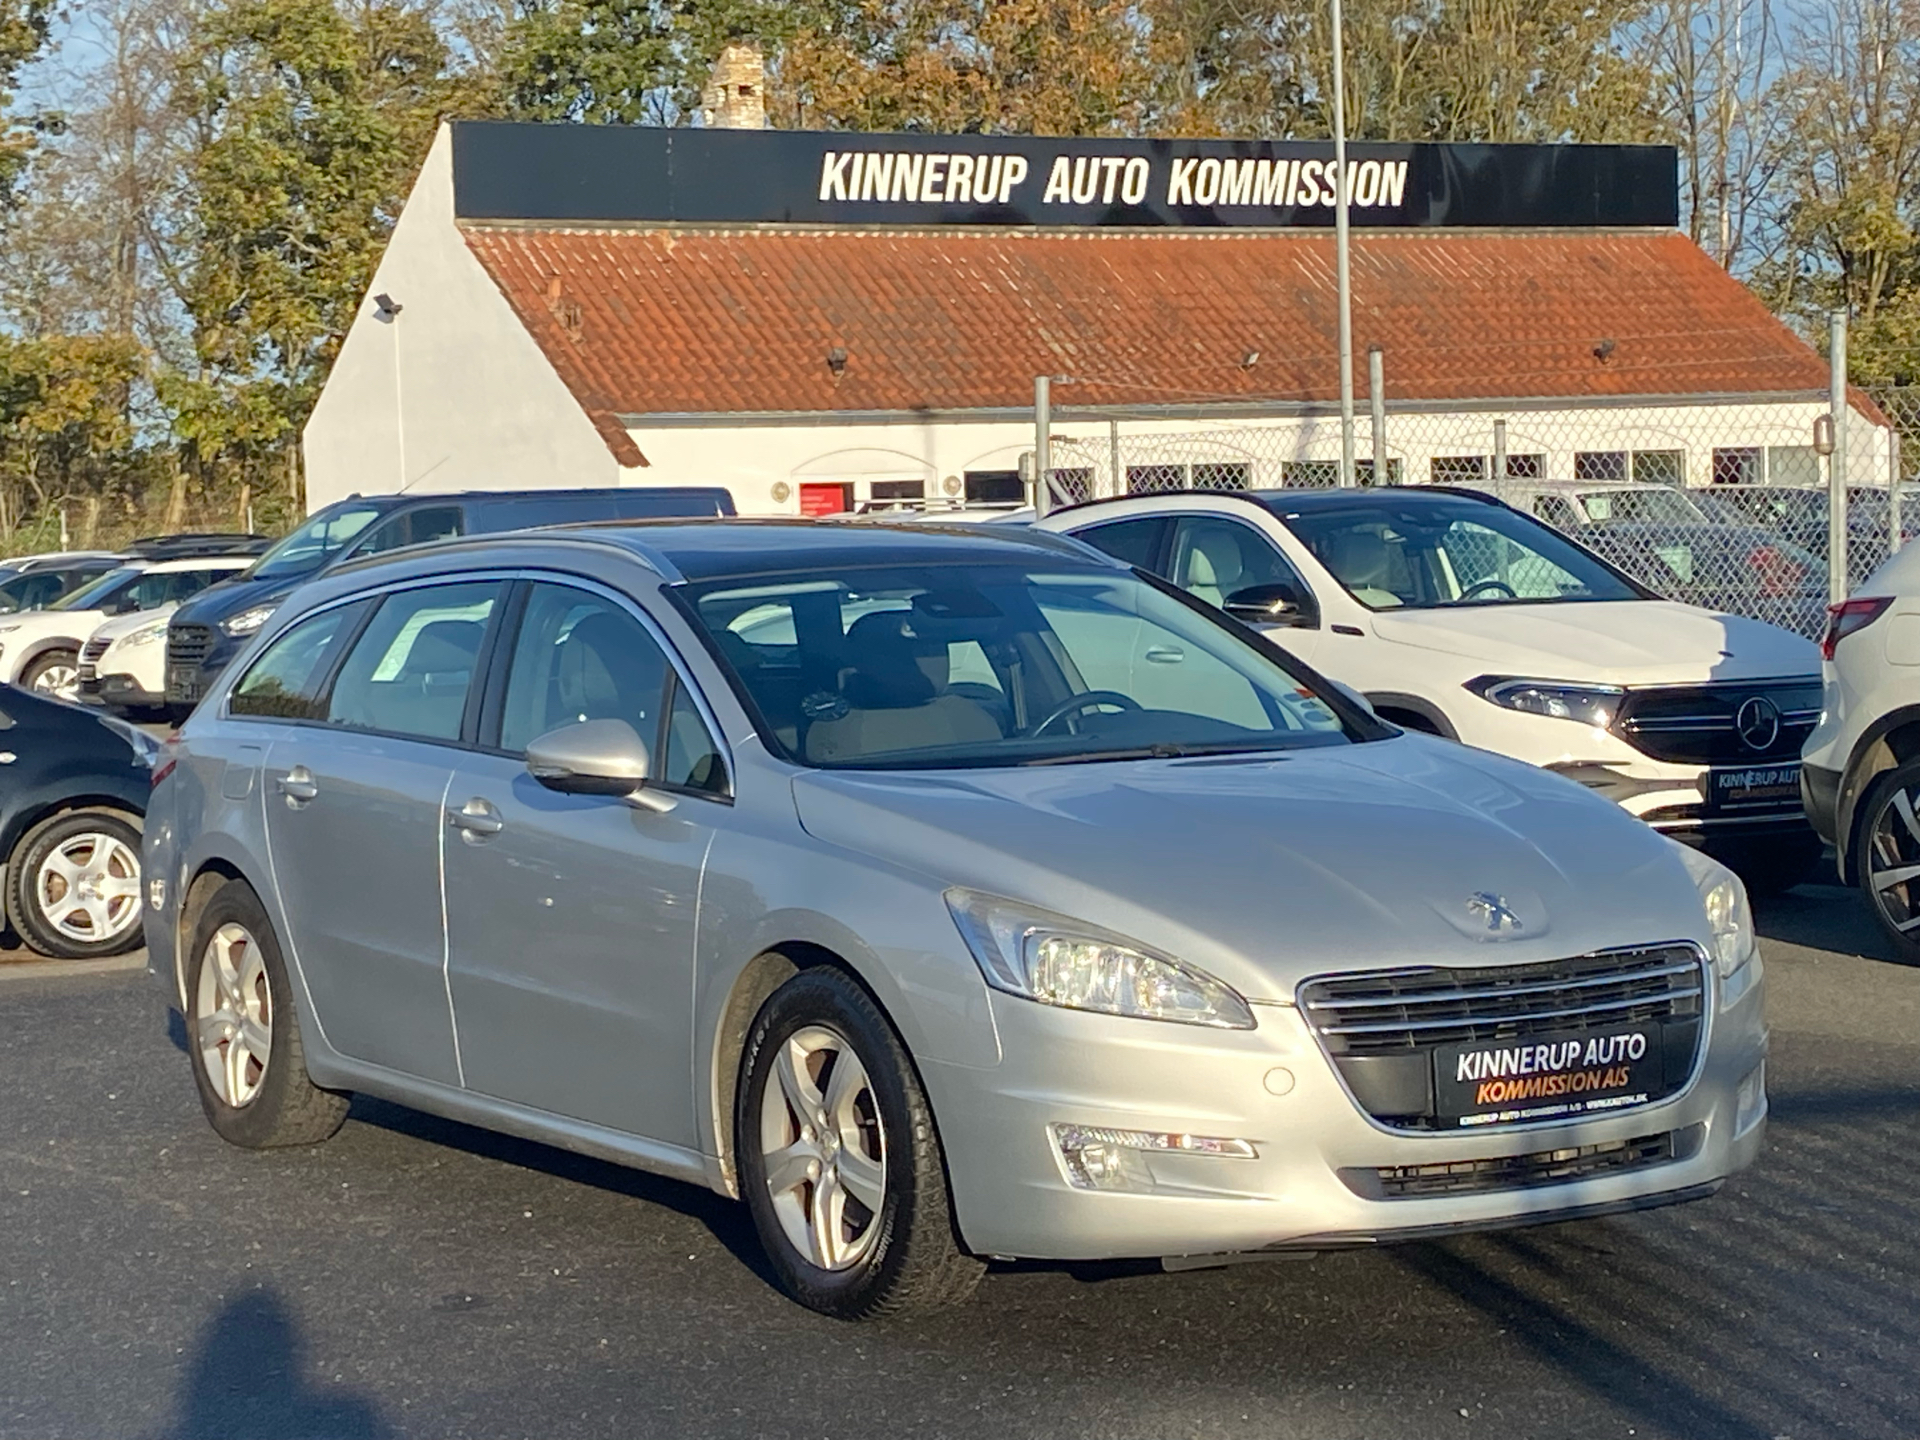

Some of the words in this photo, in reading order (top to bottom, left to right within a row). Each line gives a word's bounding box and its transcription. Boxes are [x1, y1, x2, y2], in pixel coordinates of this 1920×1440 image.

[819, 152, 1028, 201] KINNERUP
[1043, 156, 1149, 204] AUTO
[1168, 158, 1408, 207] KOMMISSION
[1456, 1042, 1581, 1081] KINNERUP
[1583, 1033, 1647, 1067] AUTO
[1476, 1069, 1602, 1105] KOMMISSION
